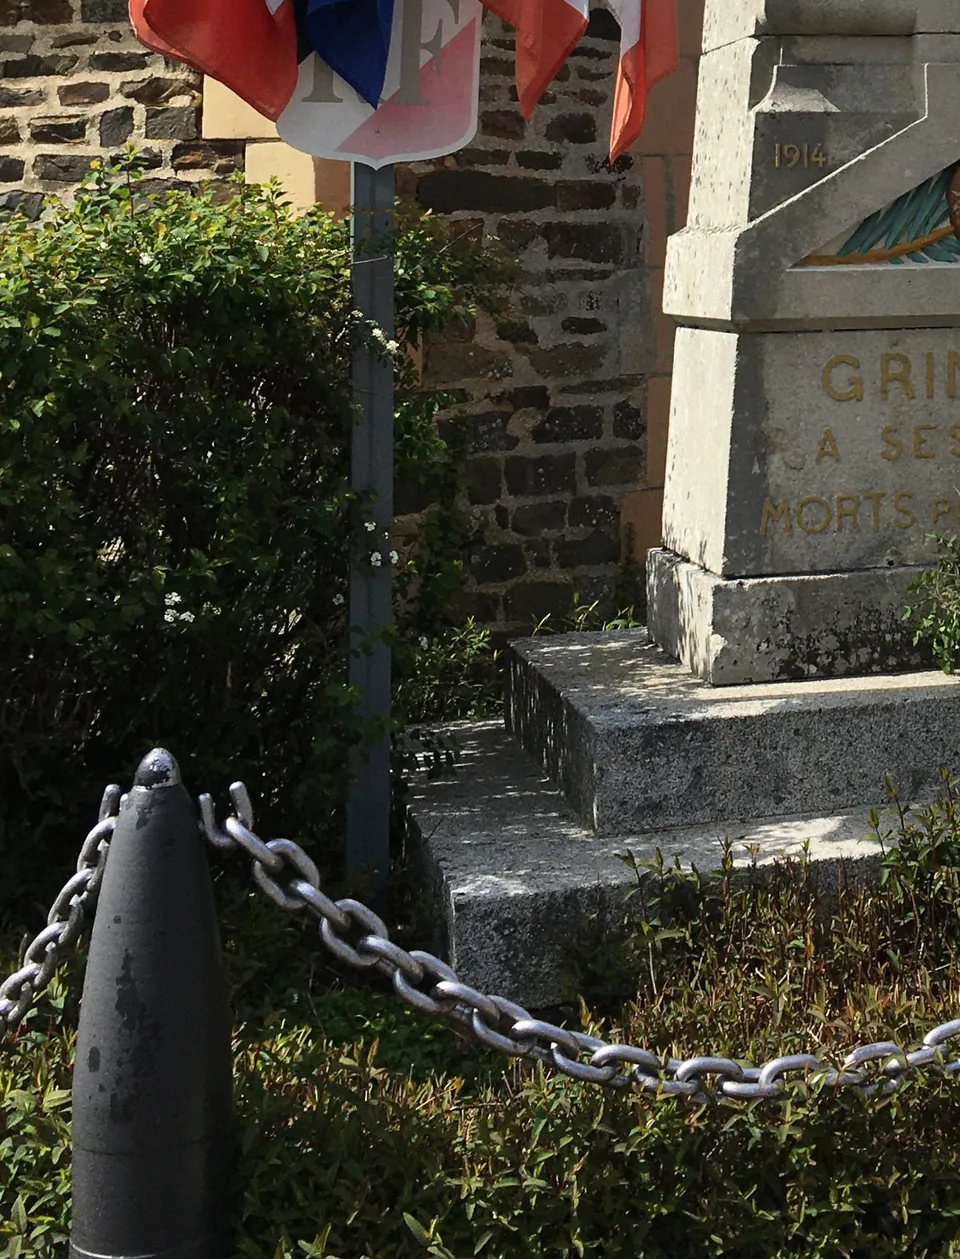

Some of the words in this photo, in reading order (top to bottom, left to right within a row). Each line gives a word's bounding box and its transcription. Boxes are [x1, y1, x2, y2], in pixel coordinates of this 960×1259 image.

[774, 142, 827, 169] 1914
[815, 427, 841, 463] A
[760, 490, 917, 537] MORTS
